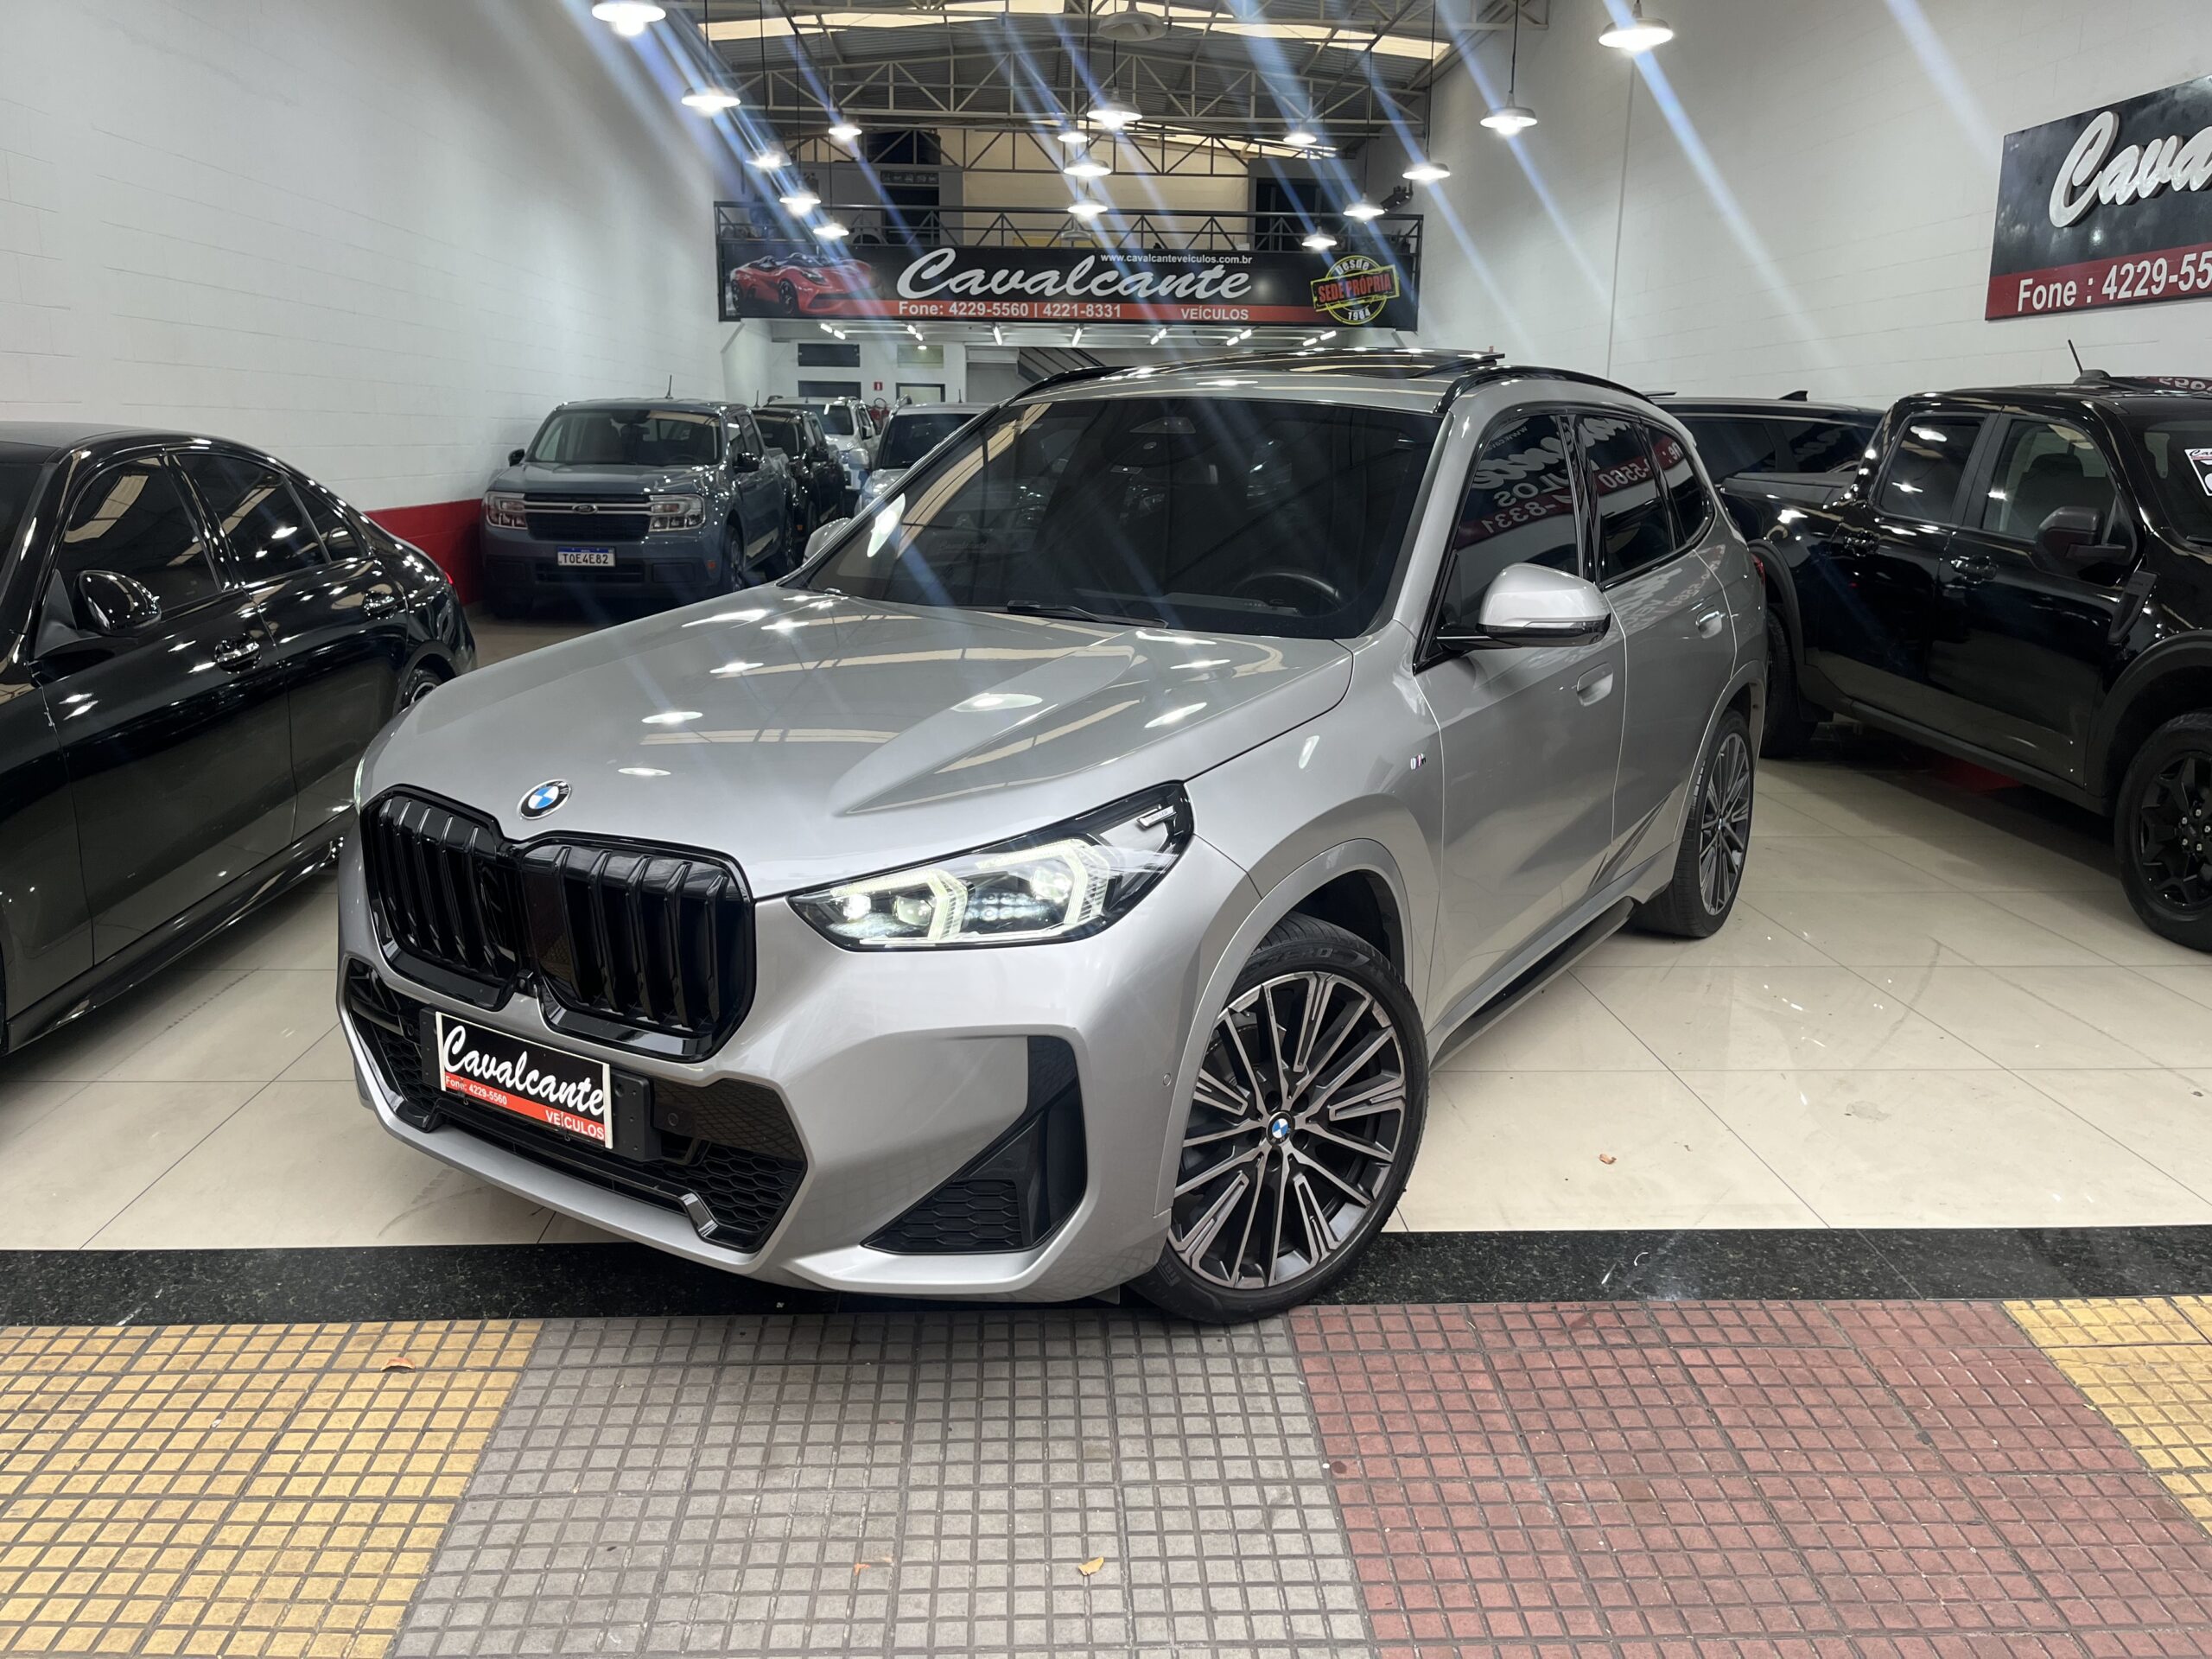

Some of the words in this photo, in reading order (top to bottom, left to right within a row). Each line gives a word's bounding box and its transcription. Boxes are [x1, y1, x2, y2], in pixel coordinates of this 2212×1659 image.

[2049, 111, 2212, 228] Cava
[1100, 253, 1253, 264] www.cavalcanteveiculos.com.br
[1335, 258, 1370, 276] Desde
[897, 248, 1252, 299] Cavalcante
[2017, 278, 2077, 313] Fone
[2101, 250, 2212, 301] 4229-55
[1318, 282, 1344, 303] SEDE
[1345, 272, 1392, 298] PRÓPRIA
[899, 301, 944, 315] Fone:
[949, 302, 1029, 316] 4229-5560
[1043, 302, 1122, 318] 4221-8331
[1180, 304, 1249, 321] VEÍCULOS
[1348, 308, 1371, 321] 1984
[563, 553, 609, 564] TOE4E82
[442, 1025, 605, 1116] Cavalcante
[468, 1084, 508, 1105] 4229-5560
[545, 1109, 605, 1140] VEÍCULOS
